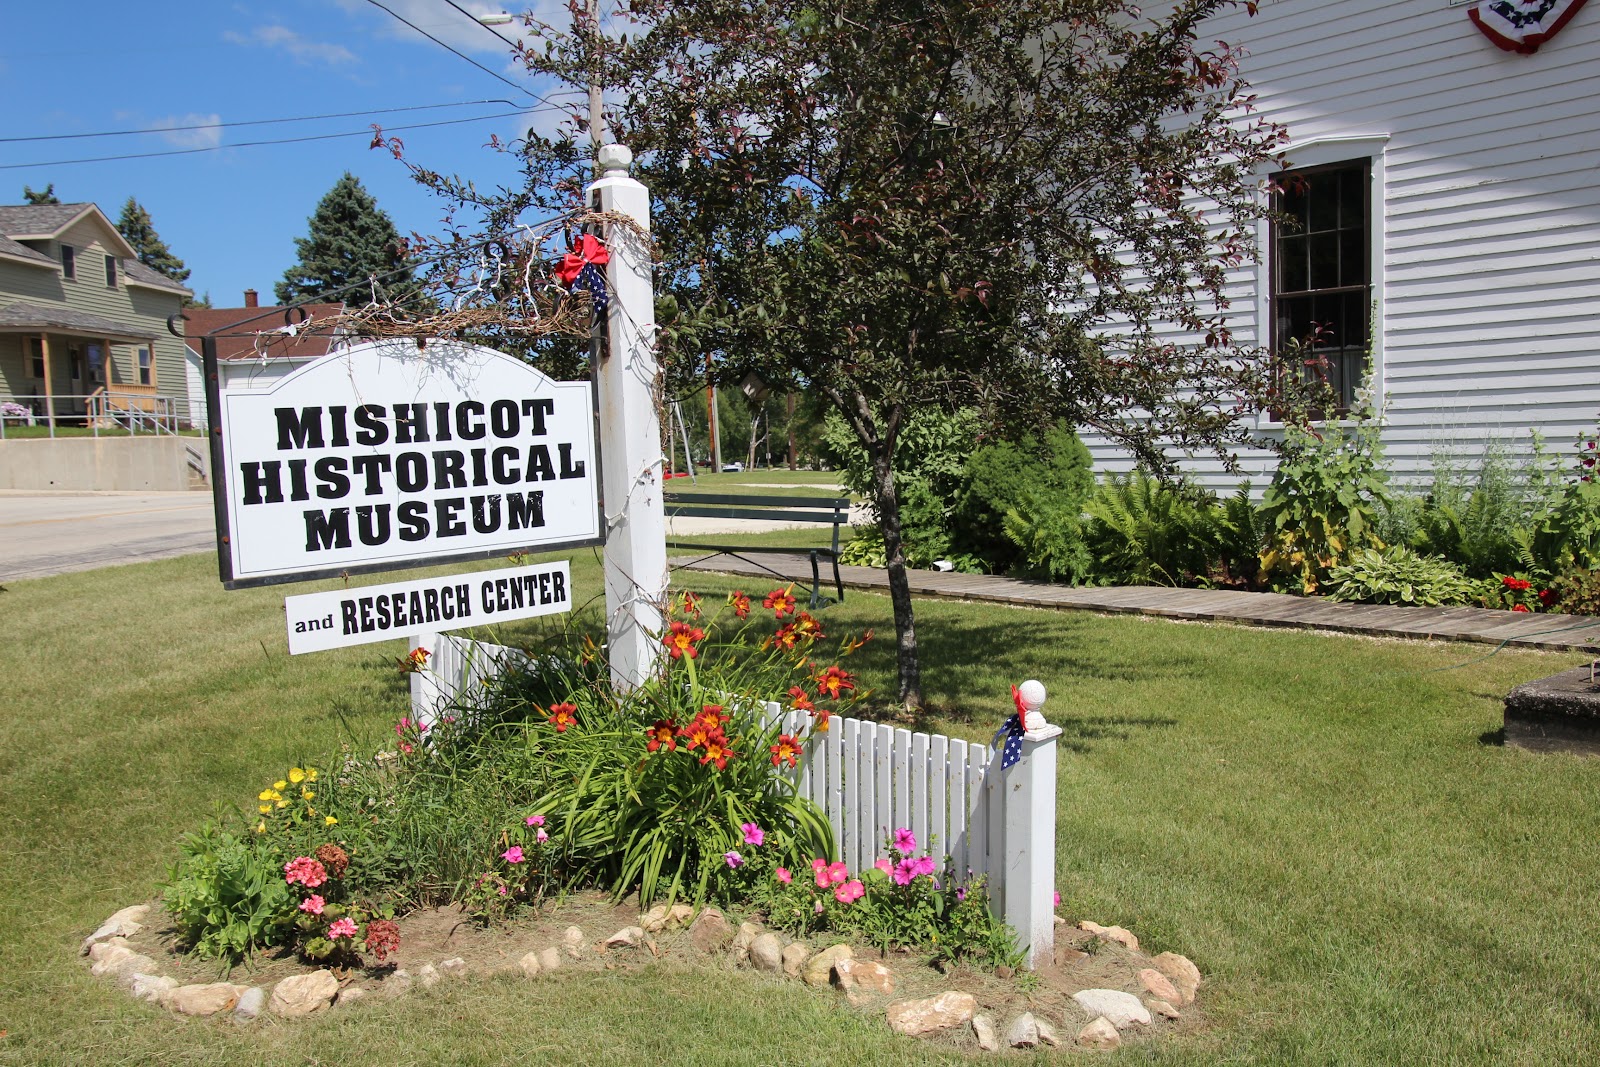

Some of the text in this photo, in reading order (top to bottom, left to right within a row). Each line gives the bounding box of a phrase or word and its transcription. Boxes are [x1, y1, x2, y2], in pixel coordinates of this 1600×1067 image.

[274, 398, 554, 451] MISHICOT
[240, 443, 586, 505] HISTORICAL
[303, 490, 546, 552] MUSEUM
[294, 570, 566, 635] and RESEARCH CENTER
